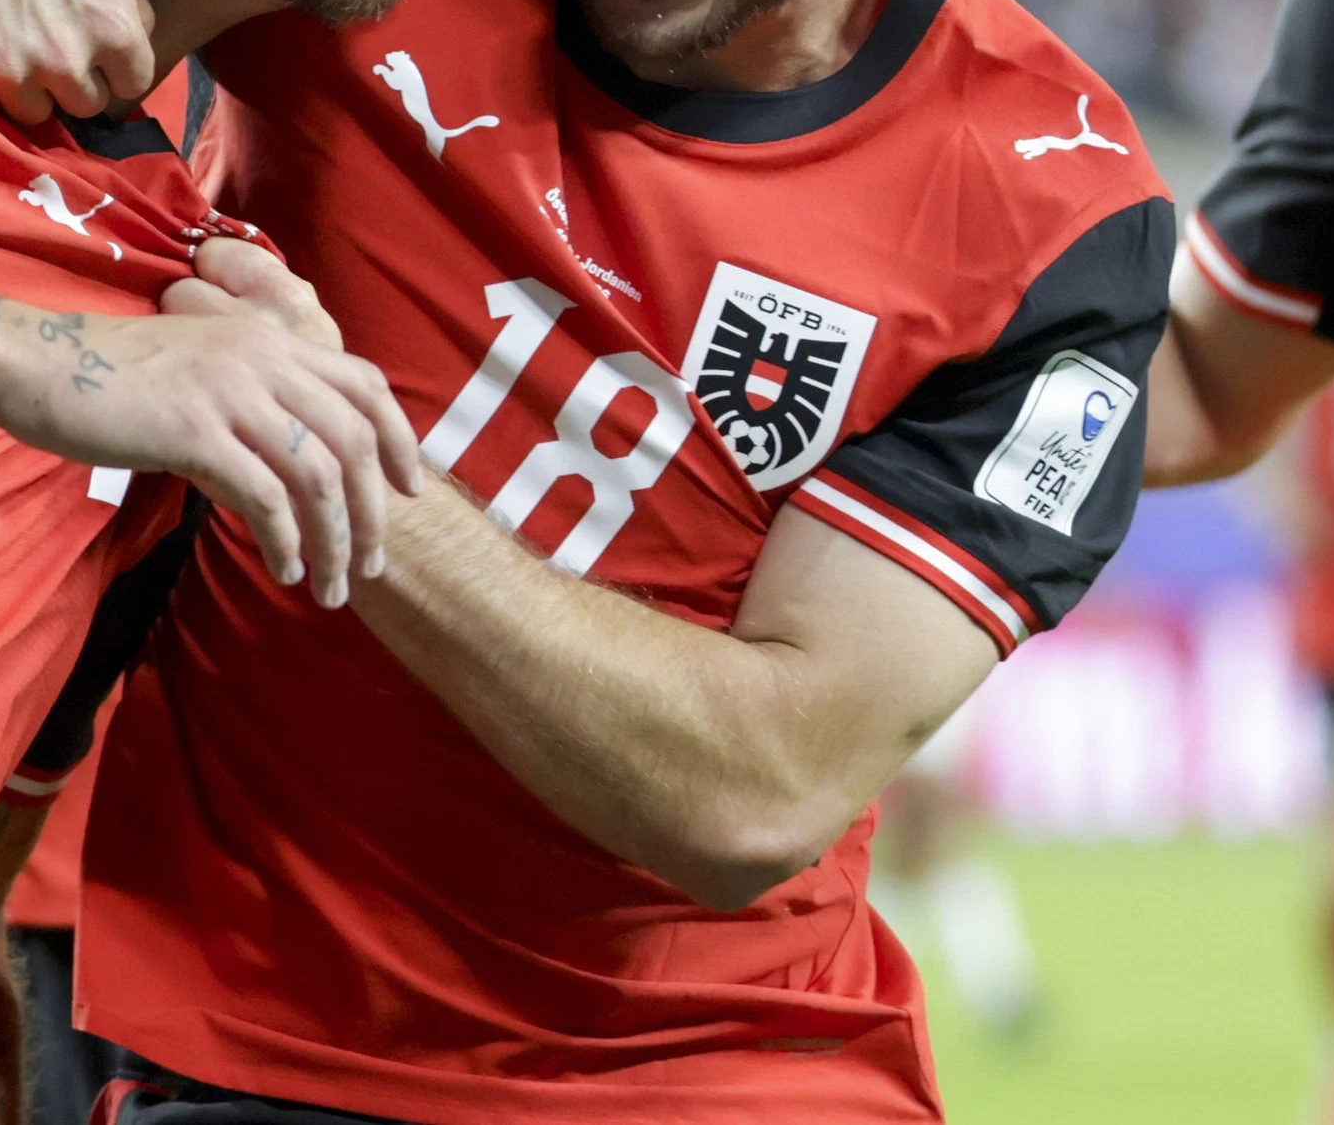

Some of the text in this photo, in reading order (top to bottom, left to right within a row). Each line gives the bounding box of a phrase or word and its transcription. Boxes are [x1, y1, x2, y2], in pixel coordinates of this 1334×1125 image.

[579, 257, 643, 304] Jordanien
[758, 292, 823, 331] ÖFB
[416, 276, 697, 580] 18
